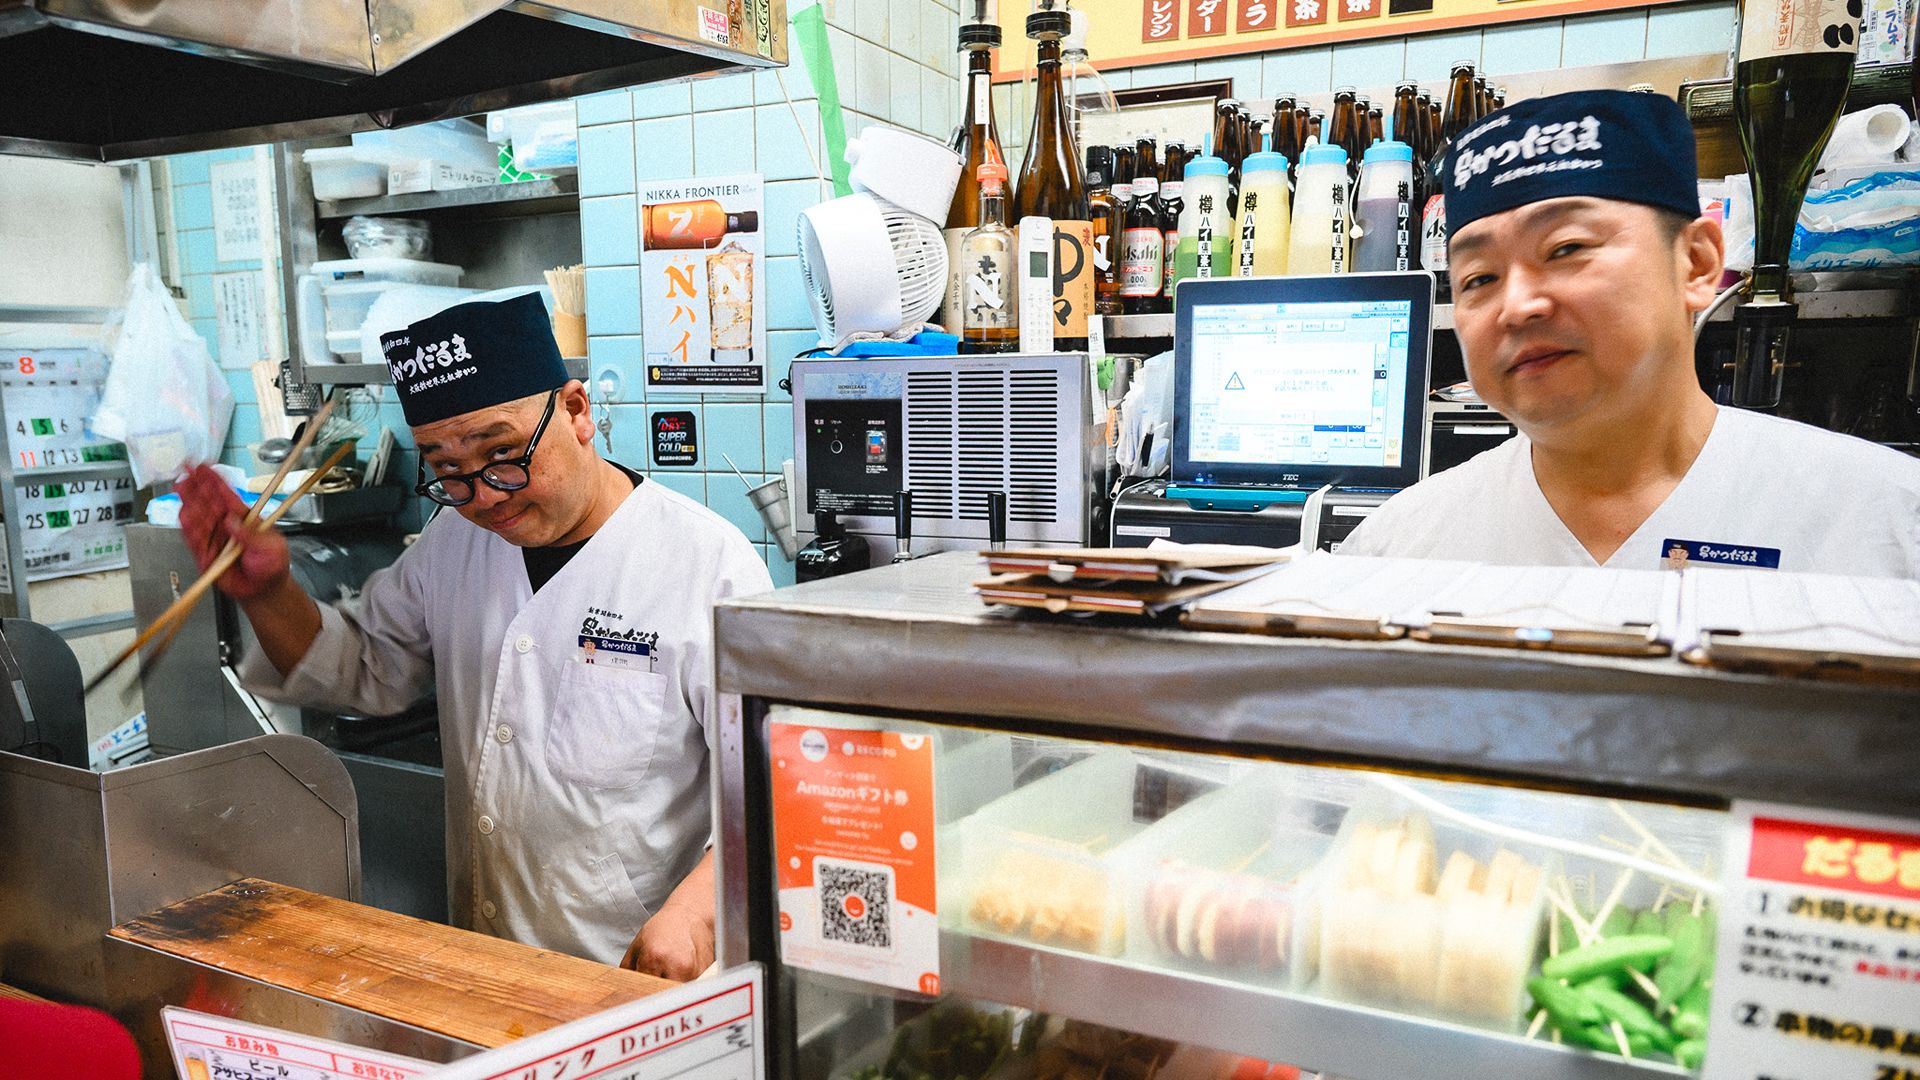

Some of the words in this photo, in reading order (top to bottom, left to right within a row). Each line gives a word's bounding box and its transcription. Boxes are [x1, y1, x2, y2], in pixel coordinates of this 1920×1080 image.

[1885, 9, 1899, 45] ラムネ
[646, 189, 681, 201] NIKKA
[685, 184, 740, 199] FRONTIER
[19, 356, 36, 375] 8
[16, 420, 26, 436] 4
[39, 420, 49, 435] 5
[658, 432, 687, 441] SUPER
[658, 443, 681, 452] COLD
[20, 450, 37, 468] 11
[42, 450, 56, 465] 12
[61, 449, 79, 464] 13
[1283, 473, 1299, 481] TEC
[24, 482, 40, 499] 18
[26, 514, 44, 530] 25
[50, 511, 68, 527] 26
[73, 509, 90, 525] 27
[96, 505, 113, 522] 28
[621, 1015, 703, 1054] Drinks
[225, 1035, 279, 1056] お飲み物
[249, 1058, 288, 1077] ビール
